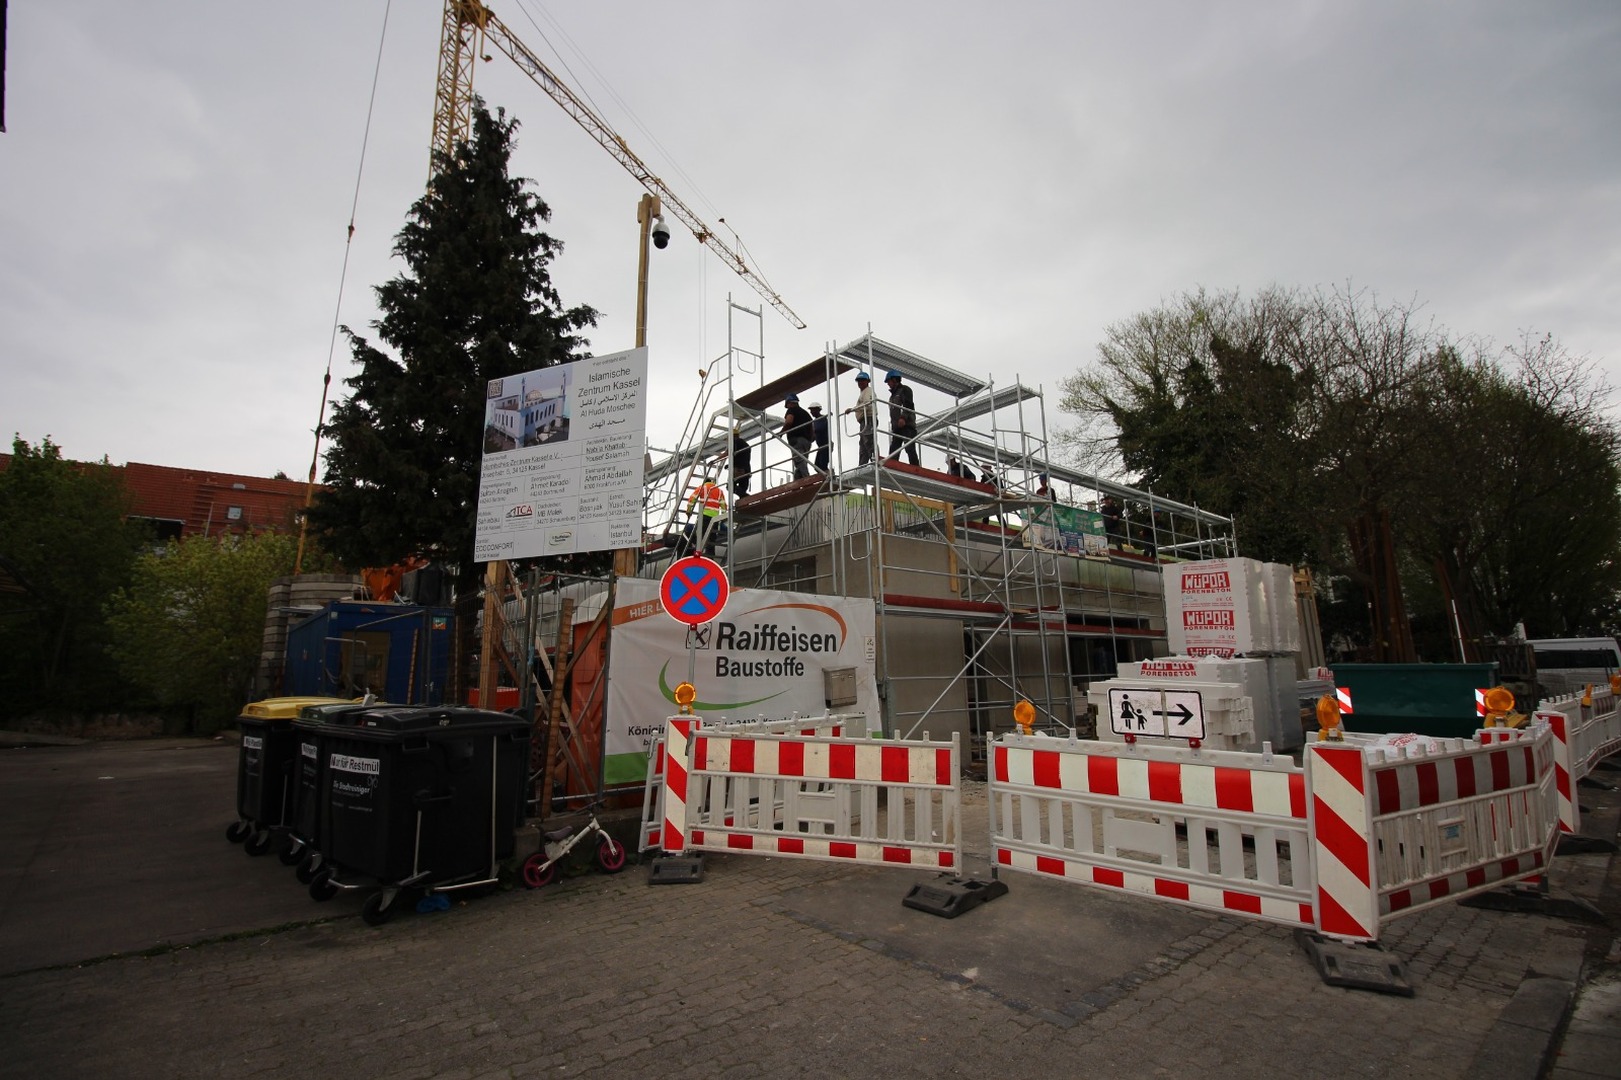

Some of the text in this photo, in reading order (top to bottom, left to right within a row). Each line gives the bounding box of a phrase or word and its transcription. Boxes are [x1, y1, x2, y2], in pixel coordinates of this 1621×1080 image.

[589, 368, 630, 383] Islamische
[578, 377, 640, 397] Zentrum Kassel
[580, 402, 636, 418] Al Huda Moschee
[528, 463, 546, 471] Kassel
[584, 469, 633, 482] Ahmad Abdallah
[608, 500, 625, 509] Yusuf
[610, 529, 633, 539] Istanbul
[630, 604, 653, 618] HIER
[716, 621, 837, 653] Raiffeisen
[716, 656, 804, 678] Baustoffe
